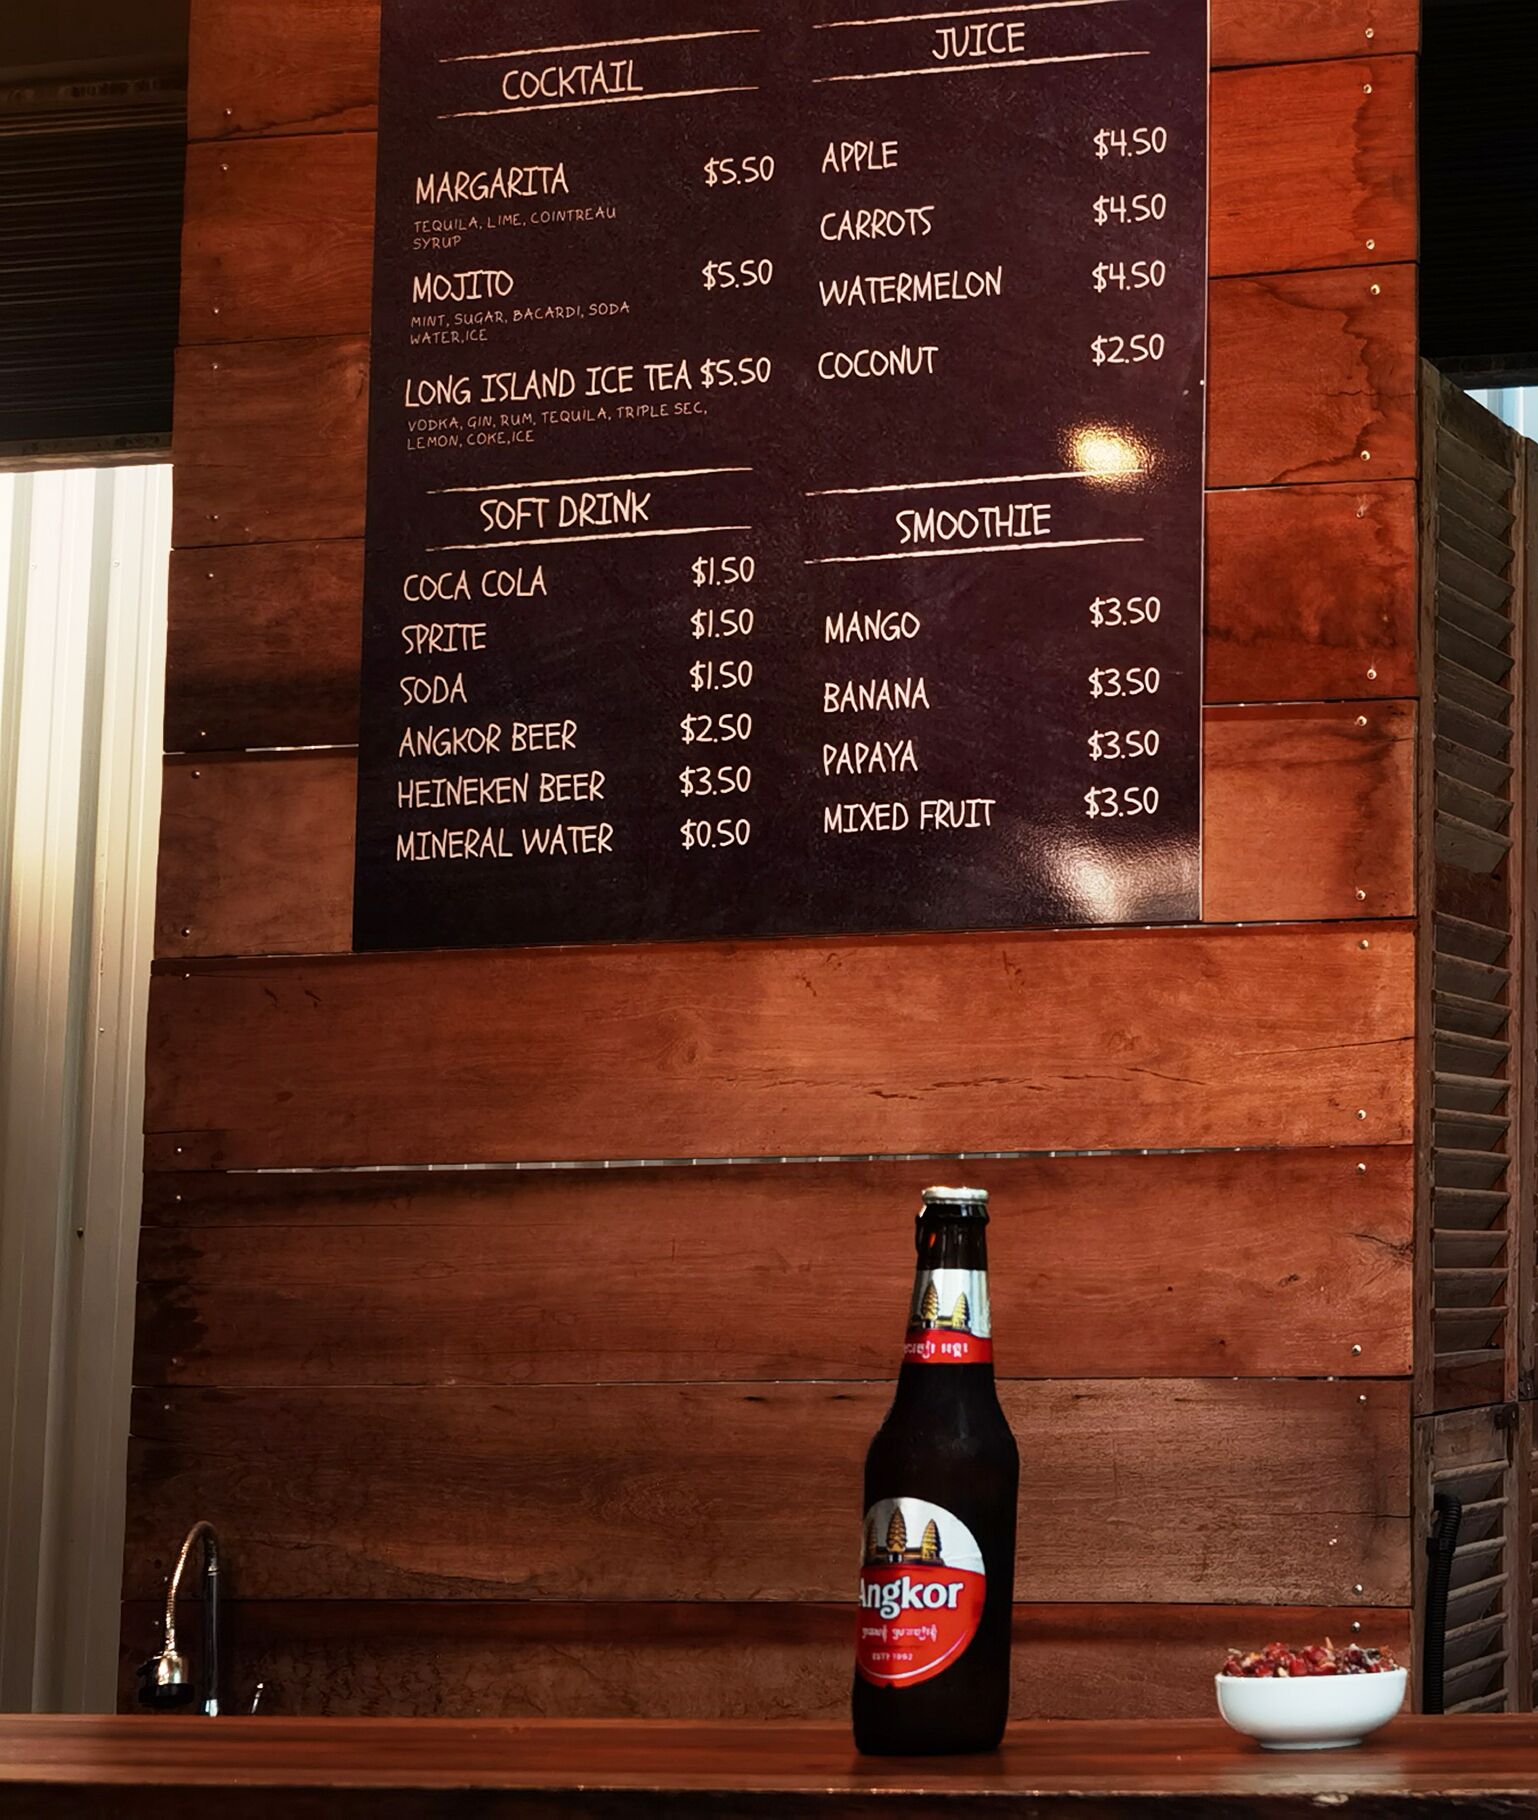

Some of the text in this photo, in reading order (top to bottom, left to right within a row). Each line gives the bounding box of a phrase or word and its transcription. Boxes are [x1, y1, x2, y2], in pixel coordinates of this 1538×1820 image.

[932, 23, 1026, 60] JUICE
[502, 60, 644, 100] COCKTAIL
[822, 127, 1167, 173] APPLE $4.50
[416, 156, 774, 204] MARGARITA $5.50
[414, 207, 615, 232] TEQUILA, LIME, COINTREAU
[821, 194, 1166, 240] CARROTS $4.50
[414, 235, 461, 249] SYRUP
[413, 259, 772, 302] MOJITO $5.50
[819, 260, 1165, 306] WATERMELON $4.50
[411, 301, 629, 327] MINT, SUGAR, BACARDI, SODA
[818, 334, 1164, 379] COCONUT $2.50
[406, 357, 771, 406] LONG ISLAND ICE TEA $5.50
[409, 402, 707, 431] VODKA, GIN, RUM, TEQUILA, TRIPLE SEC,
[408, 435, 462, 450] LEMON,
[480, 489, 650, 531] SOFT DRINK
[896, 504, 1052, 543] SMOOTHIE
[404, 556, 754, 601] COCA COLA $1.50
[402, 609, 753, 654] SPRITE $1.50
[826, 597, 1160, 643] MANGO $3.50
[400, 661, 752, 705] SODA $1.50
[824, 667, 1159, 712] BANANA $3.50
[399, 713, 751, 757] ANGKOR BEER $2.50
[824, 730, 1159, 775] PAPAYA $3.50
[399, 766, 751, 808] HEINEKEN BEER $3.50
[824, 787, 1158, 833] MIXED FRUIT $3.50
[397, 819, 750, 861] MINERAL WATER $0.50
